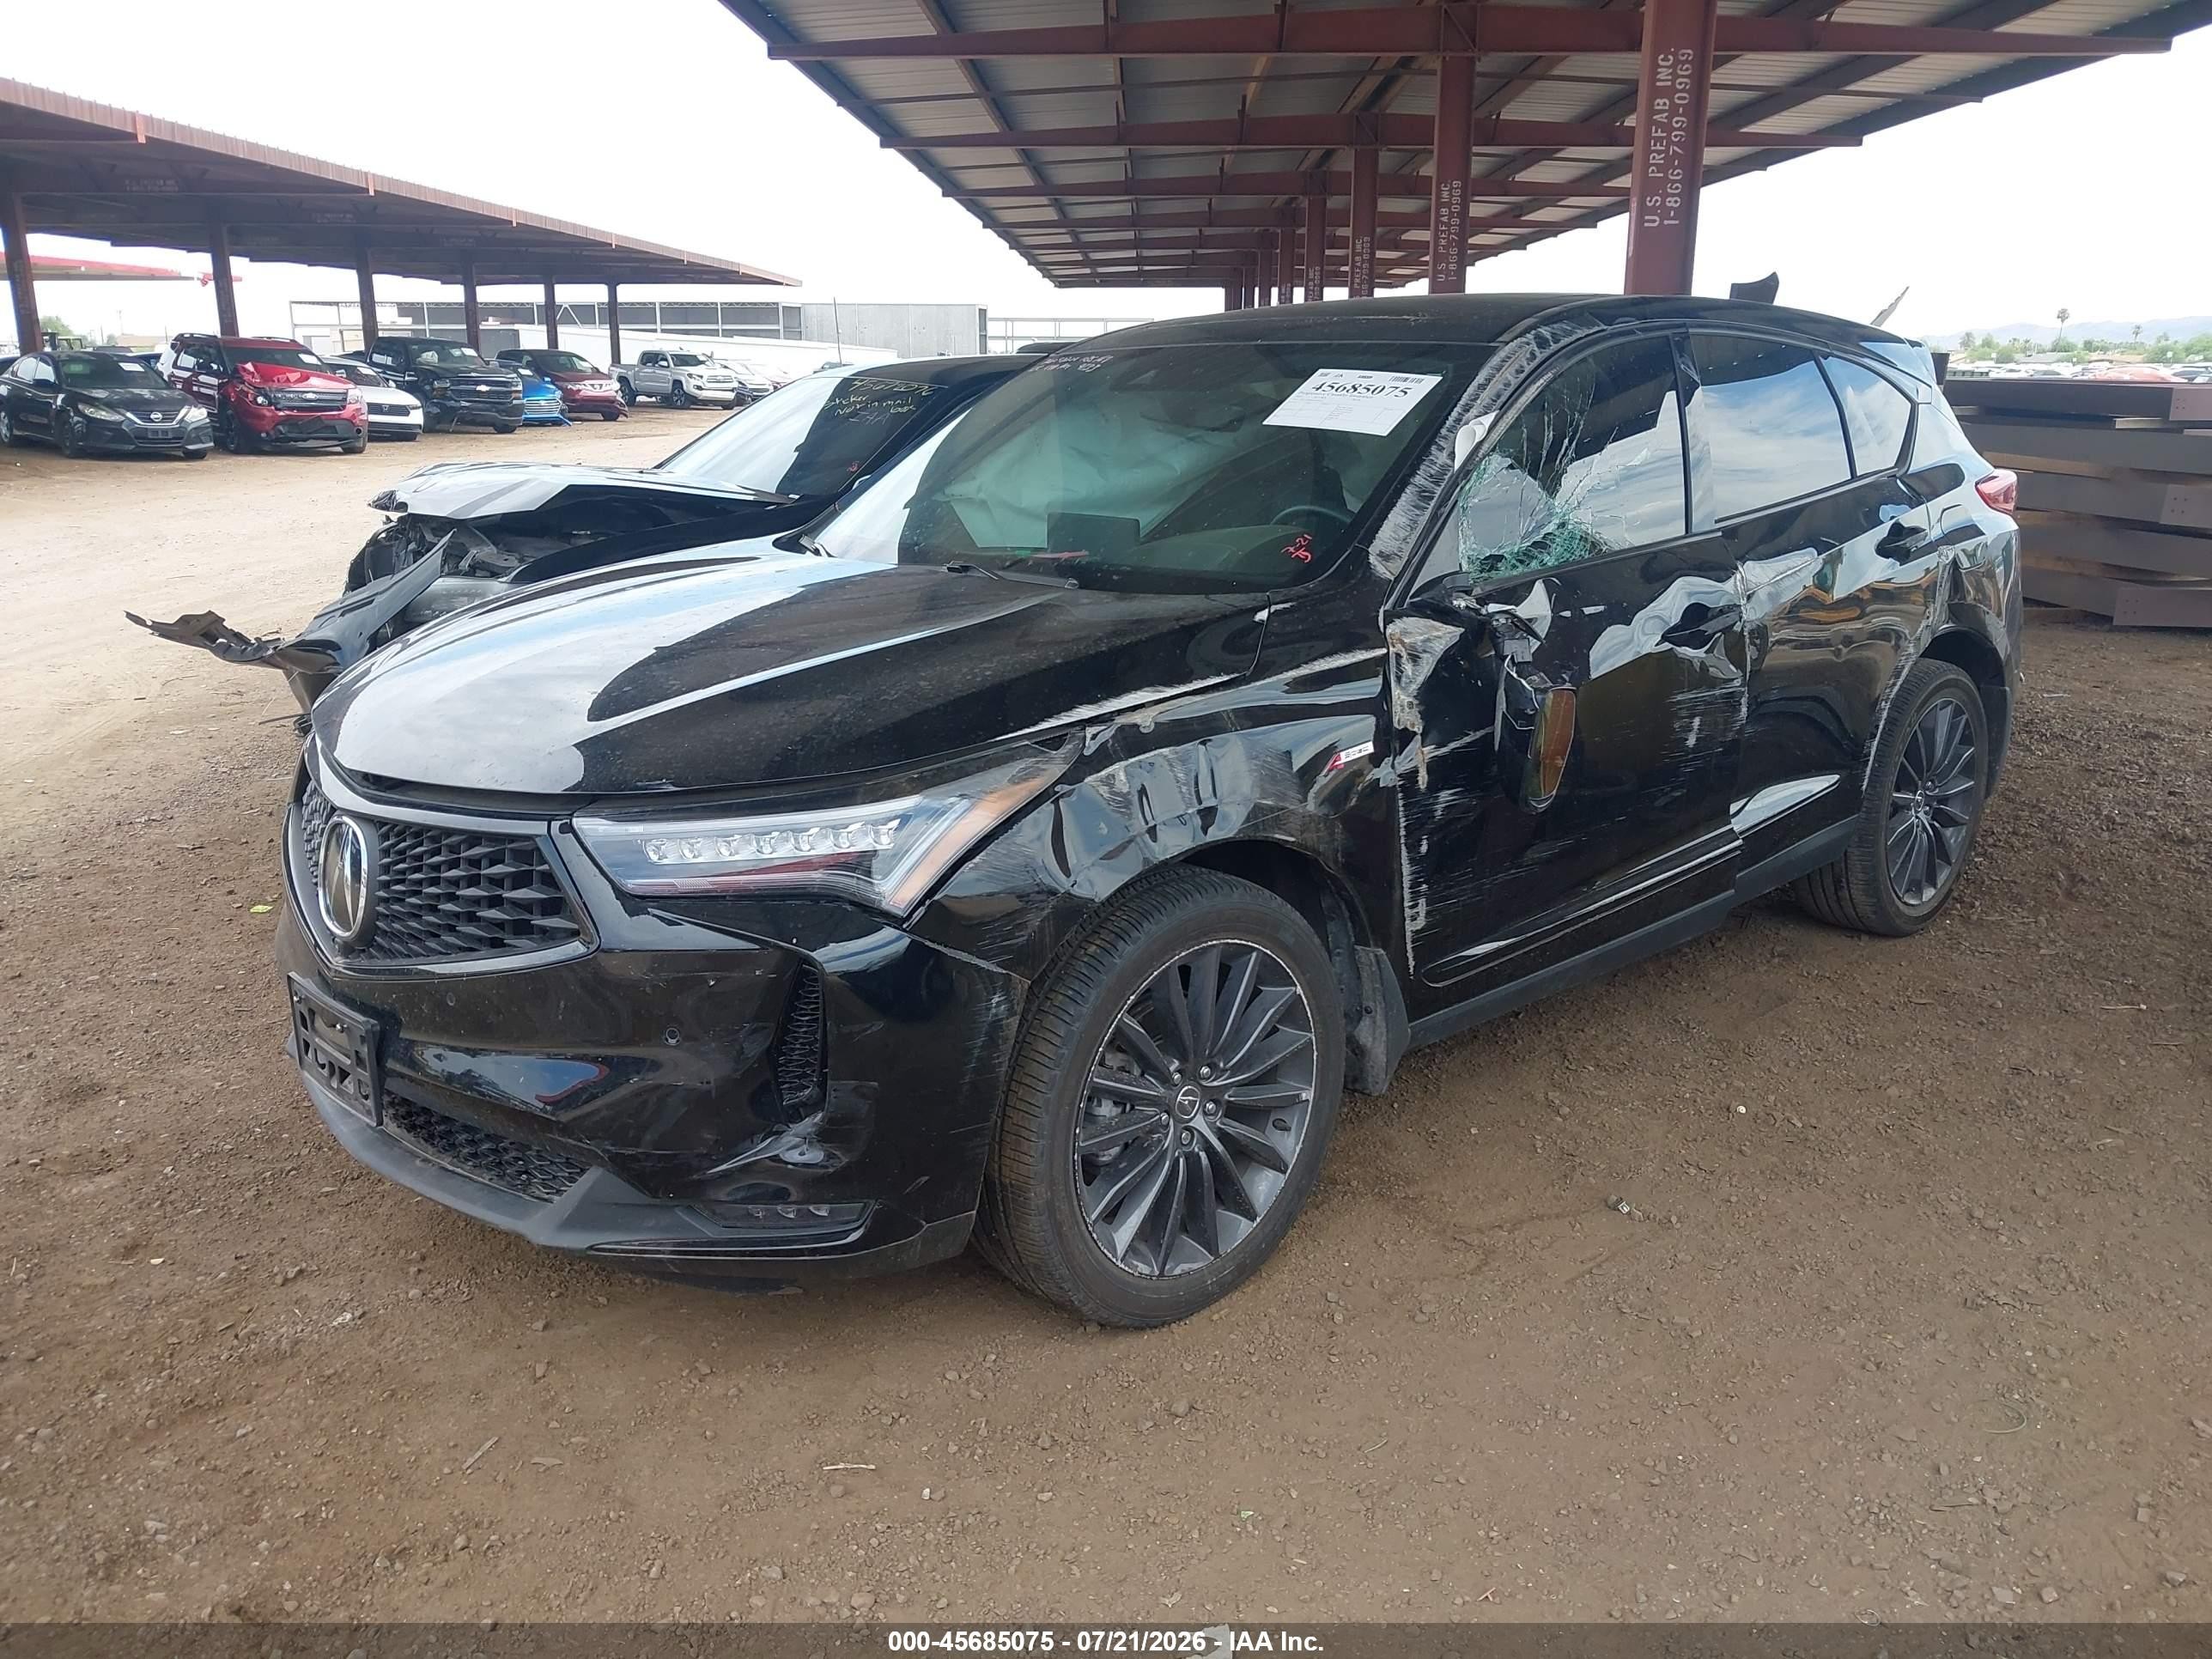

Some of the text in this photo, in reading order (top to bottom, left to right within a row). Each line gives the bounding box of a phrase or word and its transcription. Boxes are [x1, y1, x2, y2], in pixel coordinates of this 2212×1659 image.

[1644, 47, 1674, 228] U.S. PREFAB INC.
[1663, 49, 1693, 225] 1-866-799-0969
[1438, 208, 1449, 252] PREFAB
[1449, 180, 1462, 281] 1-866-799-0969
[1312, 381, 1413, 398] 45685075
